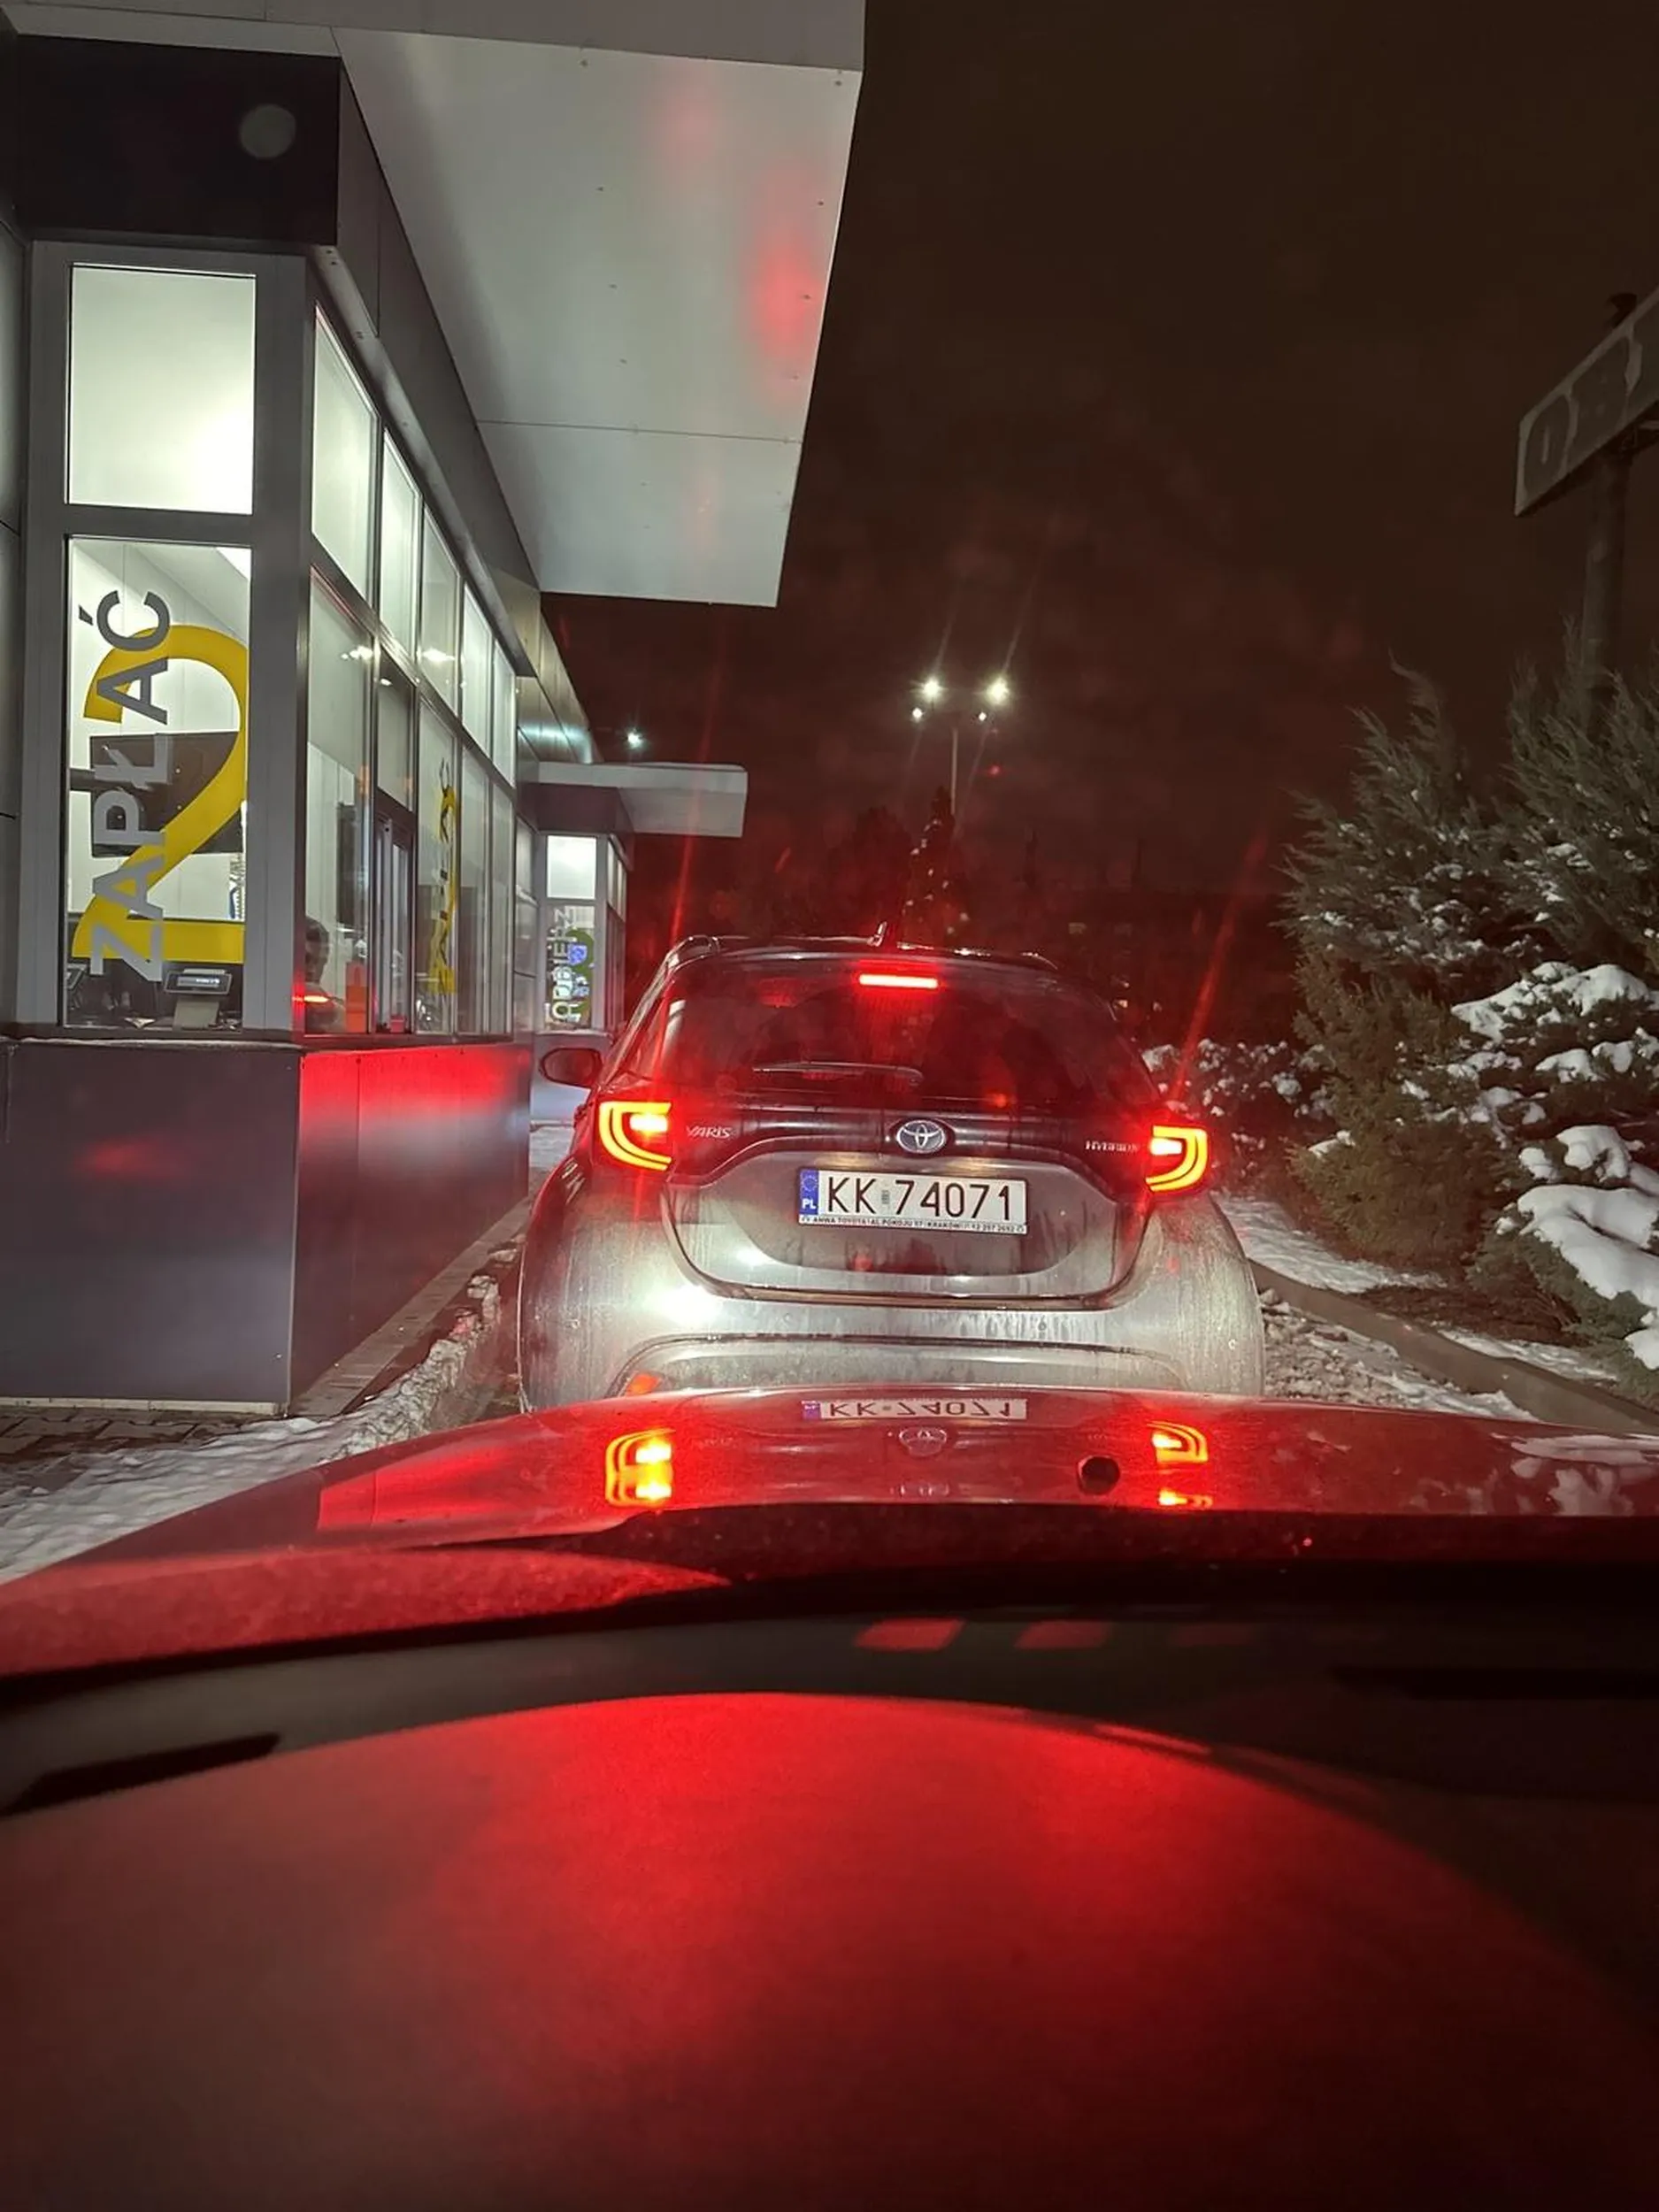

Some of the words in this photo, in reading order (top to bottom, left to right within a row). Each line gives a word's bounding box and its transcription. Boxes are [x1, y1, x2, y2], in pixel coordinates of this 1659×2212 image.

[72, 625, 249, 964] 2
[79, 590, 171, 982] ZAPŁAĆ
[686, 1125, 732, 1139] YARIS
[802, 1199, 816, 1210] PL
[827, 1177, 877, 1214] KK
[895, 1179, 1010, 1221] 74071
